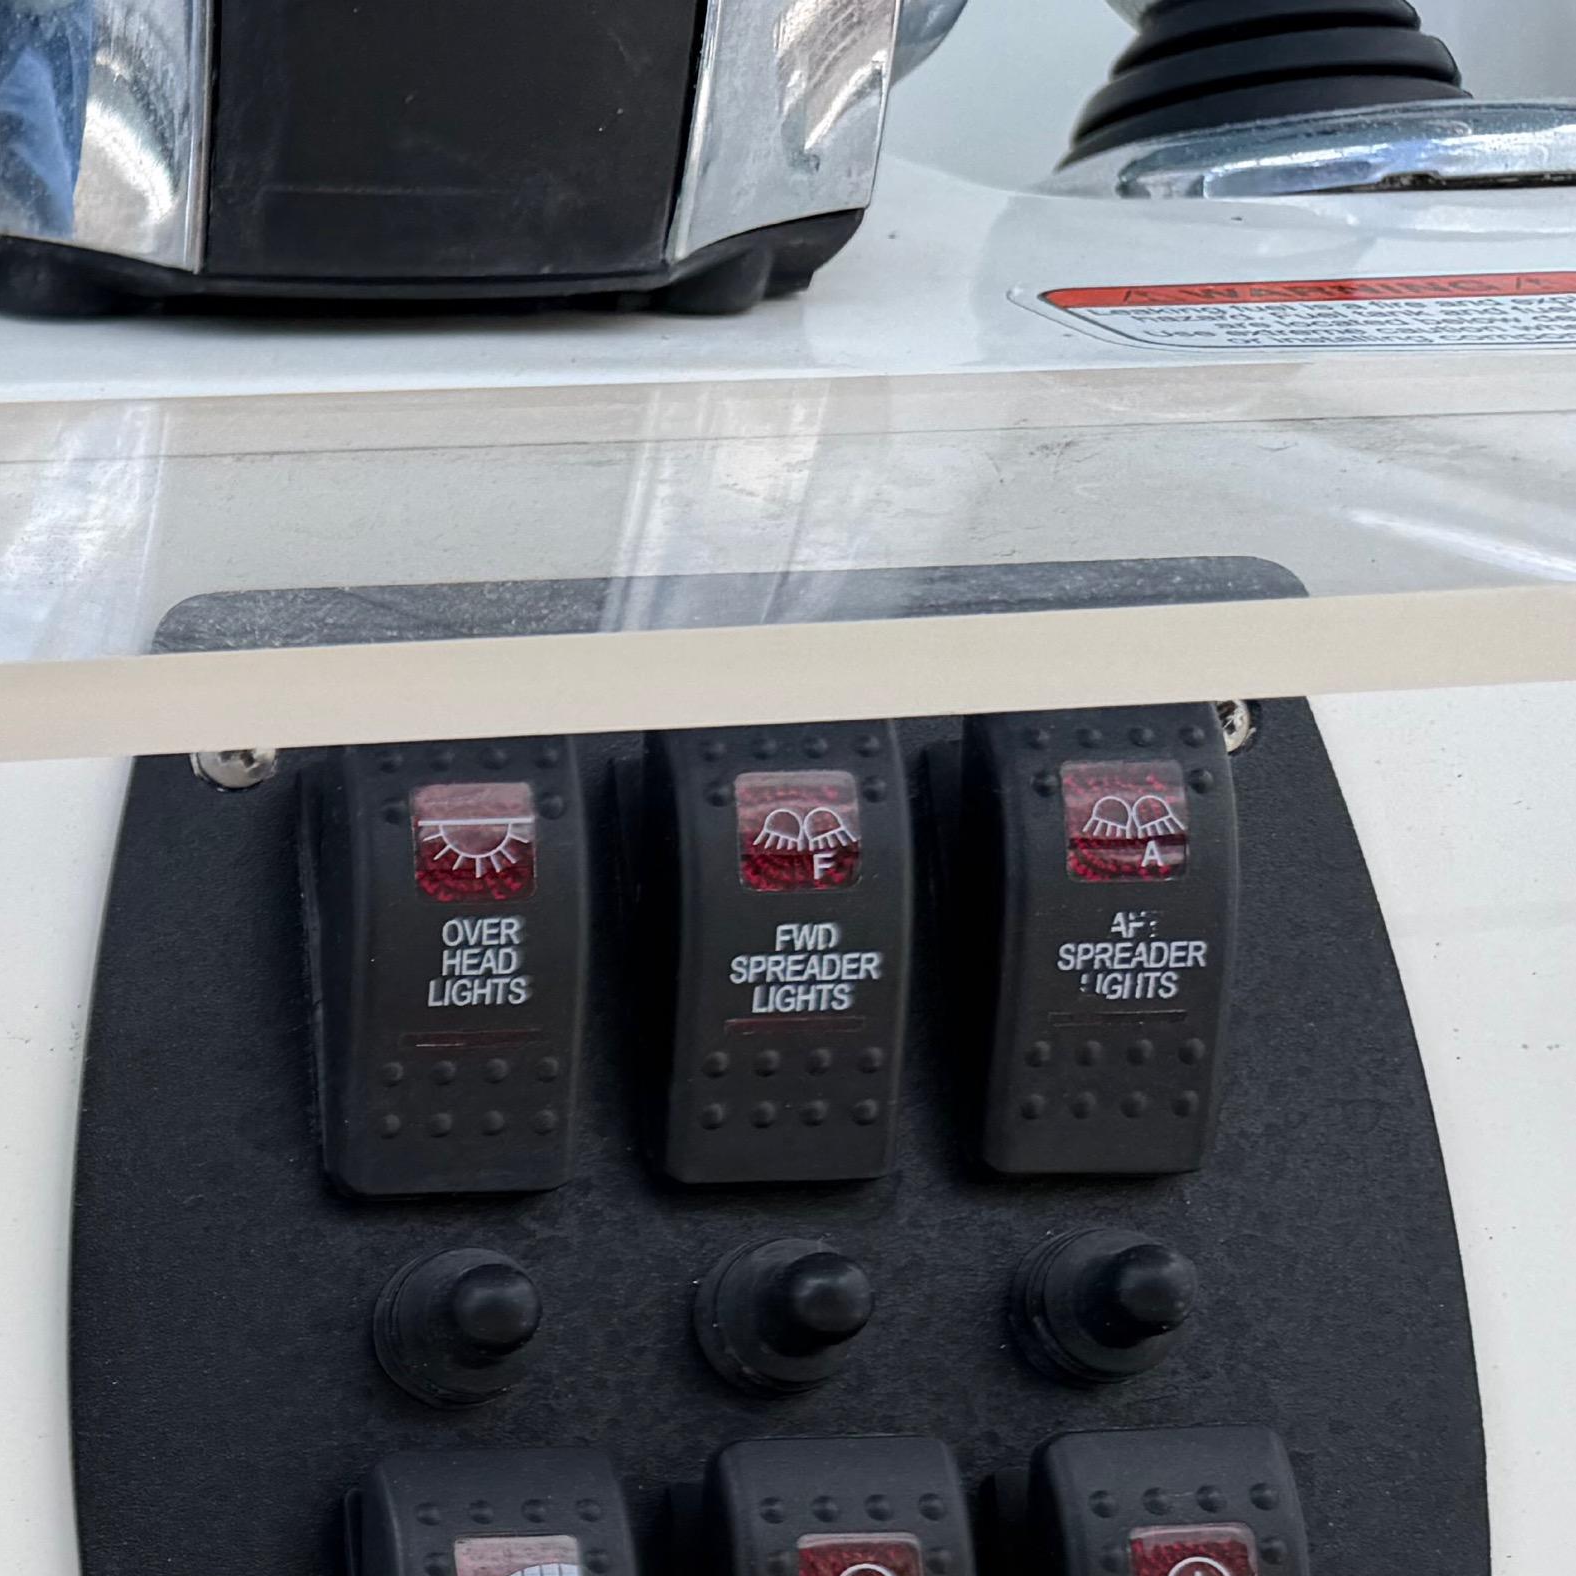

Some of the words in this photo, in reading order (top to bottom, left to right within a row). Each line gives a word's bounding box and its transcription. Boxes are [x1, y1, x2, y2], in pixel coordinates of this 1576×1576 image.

[1178, 281, 1501, 298] WARNING
[813, 852, 834, 880] F
[1141, 840, 1164, 867] A
[442, 917, 521, 948] OVER
[775, 923, 839, 951] FWD
[442, 948, 519, 977] HEAD
[729, 952, 880, 984] SPREADER
[1056, 941, 1207, 970] SPREADER
[428, 977, 527, 1007] LIGHTS
[751, 983, 851, 1013] LIGHTS
